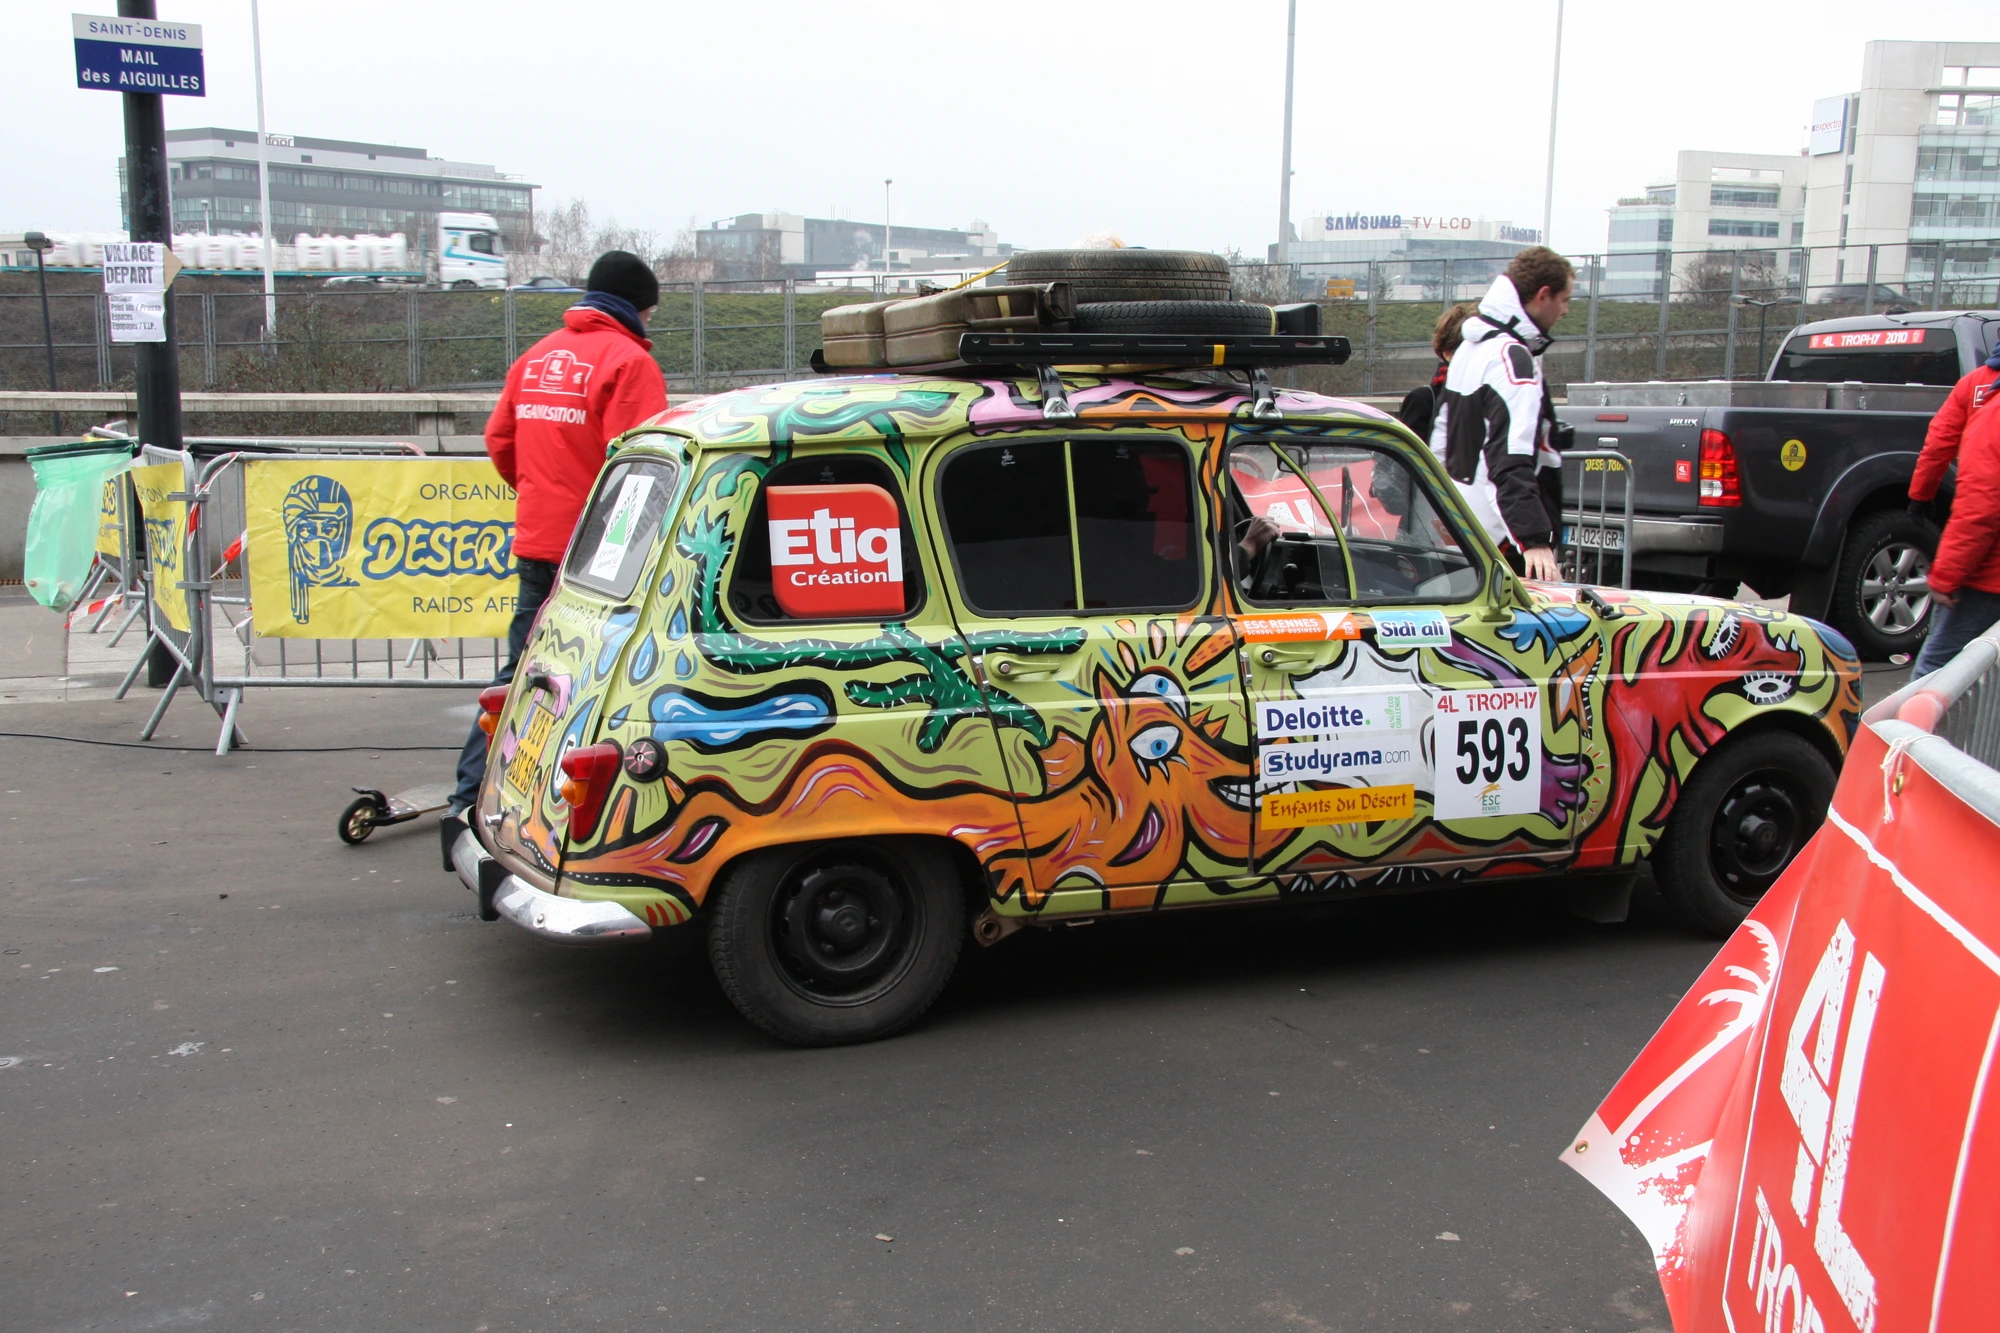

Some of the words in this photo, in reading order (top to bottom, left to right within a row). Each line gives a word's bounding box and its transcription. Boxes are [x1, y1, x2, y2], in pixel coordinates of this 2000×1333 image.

[89, 21, 187, 41] SAINT-DENIS
[120, 49, 159, 66] MAIL
[82, 68, 111, 84] des
[120, 71, 200, 91] AIGUILLES
[1325, 215, 1401, 231] SAMSUNG
[1413, 217, 1433, 229] TV
[1440, 217, 1472, 230] LCD
[104, 245, 155, 262] VILLAGE
[105, 266, 153, 284] DEPART
[1823, 336, 1835, 347] 4L
[1841, 333, 1881, 346] TROPHY
[1885, 332, 1908, 344] 2010
[1669, 418, 1698, 427] HILUX
[769, 507, 904, 582] Etiq
[790, 569, 888, 587] Création
[412, 596, 474, 613] RAIDS
[1243, 620, 1268, 630] ESC
[1269, 618, 1319, 629] RENNES
[1380, 621, 1417, 638] Sidi
[1421, 621, 1445, 638] ali
[1437, 695, 1460, 713] 4L
[1466, 691, 1538, 712] TROPHY
[1394, 695, 1402, 729] CHALLENGE
[528, 710, 550, 748] 926
[1456, 716, 1531, 785] 593
[1270, 799, 1331, 818] Enfants
[1336, 797, 1356, 812] du
[1360, 792, 1408, 811] Désert
[1482, 794, 1500, 806] ESC
[1780, 918, 1886, 1333] 4L
